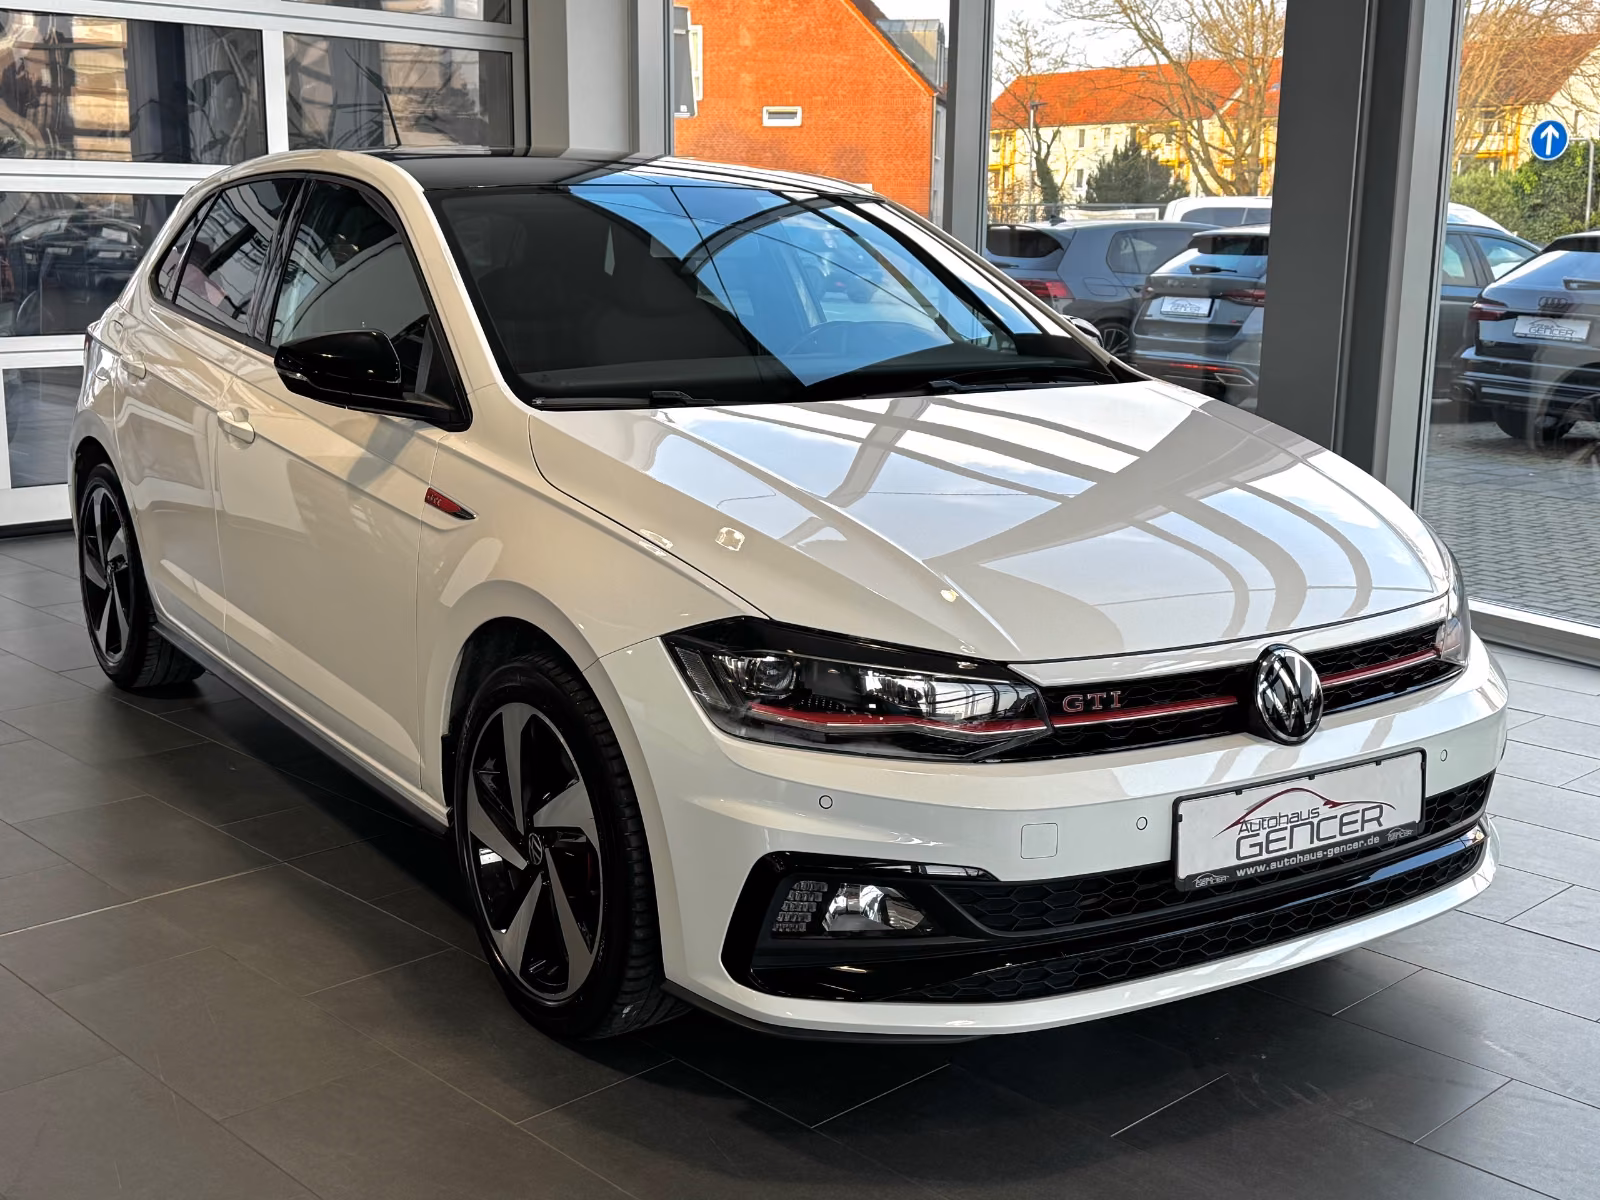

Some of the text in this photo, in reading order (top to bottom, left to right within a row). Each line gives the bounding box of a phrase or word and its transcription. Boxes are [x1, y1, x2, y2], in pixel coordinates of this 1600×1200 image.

[1062, 690, 1121, 712] GTI
[1235, 804, 1384, 861] GENCER
[1237, 806, 1320, 835] Autohaus
[1236, 835, 1380, 877] www.autohaus-gencer.de
